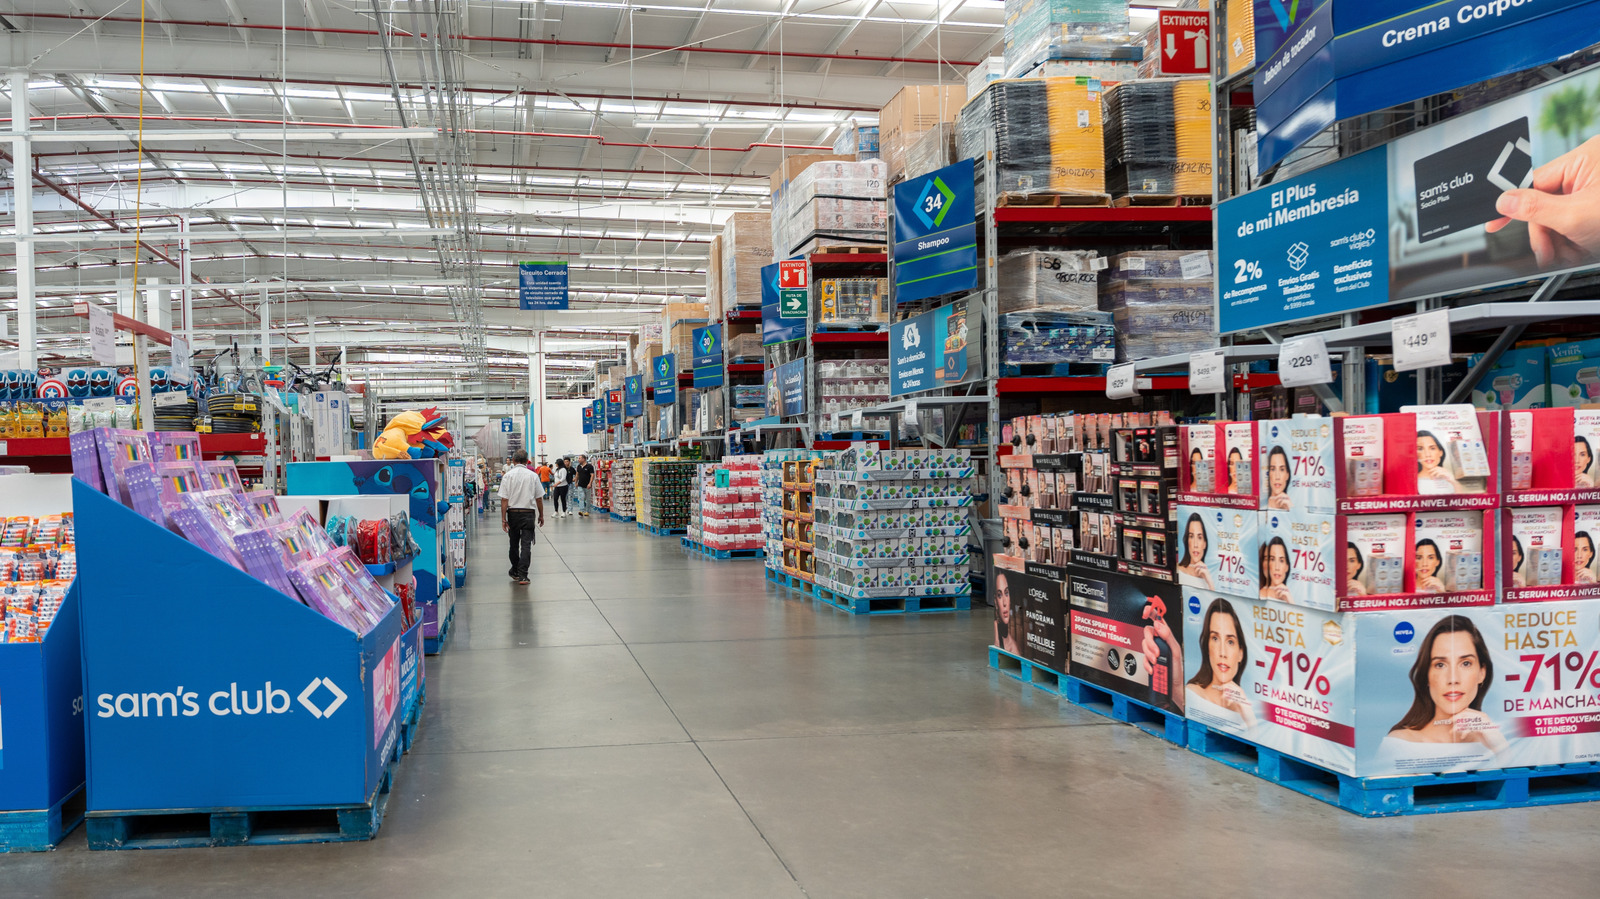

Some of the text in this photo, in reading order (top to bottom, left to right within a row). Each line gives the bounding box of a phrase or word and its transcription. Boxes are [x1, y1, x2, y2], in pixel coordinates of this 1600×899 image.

[1162, 15, 1208, 26] EXTINTOR
[1382, 0, 1533, 48] Crema Corpo
[1264, 26, 1316, 85] Jabón de tocador
[1420, 172, 1474, 201] sam's club
[925, 193, 942, 213] 34
[1271, 183, 1317, 209] El Plus
[1421, 195, 1450, 210] Socio Plus
[1237, 188, 1360, 237] de mi Membresía
[918, 236, 949, 251] Shampoo
[1330, 231, 1366, 247] sam's club
[1349, 239, 1370, 251] viajes
[1234, 258, 1263, 284] 2%
[1333, 259, 1373, 274] Beneficios
[1300, 270, 1320, 282] Gratis
[1333, 270, 1373, 285] exclusivos
[1223, 284, 1267, 299] de Recompensa
[1357, 281, 1370, 289] Club
[1551, 347, 1581, 358] Venus
[1291, 429, 1318, 438] REDUCE
[1291, 441, 1319, 452] HASTA
[1292, 455, 1325, 477] 71%
[1077, 496, 1113, 505] MAYBELLINE
[1506, 494, 1517, 502] EL
[1518, 493, 1548, 502] SERUM
[1550, 493, 1569, 501] NO.1
[1578, 491, 1600, 500] NIVEL
[1341, 502, 1353, 510] EL
[1354, 501, 1388, 510] SERUM
[1389, 500, 1411, 508] NO.1
[1421, 499, 1448, 507] NIVEL
[1034, 512, 1062, 521] MAYBELLINE
[1291, 521, 1318, 532] REDUCE
[1217, 531, 1239, 540] REDUCE
[1292, 536, 1318, 547] HASTA
[1217, 543, 1240, 552] HASTA
[1075, 554, 1110, 564] MAYBELLINE
[1218, 554, 1245, 574] 71%
[1292, 549, 1325, 573] 71%
[1029, 566, 1059, 576] MAYBELLINE
[1218, 574, 1226, 582] DE
[1292, 573, 1300, 581] DE
[1507, 591, 1517, 599] EL
[1519, 590, 1549, 599] SERUM
[1550, 589, 1570, 598] NO.1
[1578, 587, 1600, 596] NIVEL
[1353, 600, 1387, 608] SERUM
[1388, 598, 1410, 607] NO.1
[1419, 597, 1446, 605] NIVEL
[1026, 610, 1055, 626] PANORAMA
[1074, 615, 1117, 632] 2PACK SPRAY DE
[1253, 605, 1305, 628] REDUCE
[1504, 610, 1577, 629] REDUCE
[1027, 632, 1055, 650] INFAILLIBLE
[1074, 624, 1131, 645] PROTECCIÓN TÉRMICA
[1254, 622, 1306, 649] HASTA
[1504, 629, 1578, 650] HASTA
[1255, 645, 1331, 696] -71%
[1505, 650, 1600, 693] -71%
[1254, 682, 1269, 697] DE
[97, 681, 291, 718] sam's club
[1504, 698, 1525, 712] DE
[1275, 715, 1306, 730] TU DINERO
[1280, 708, 1288, 717] TE
[1288, 711, 1330, 729] DEVOLVEMOS
[1535, 718, 1542, 726] O
[1543, 717, 1553, 725] TE
[1547, 725, 1577, 734] DINERO
